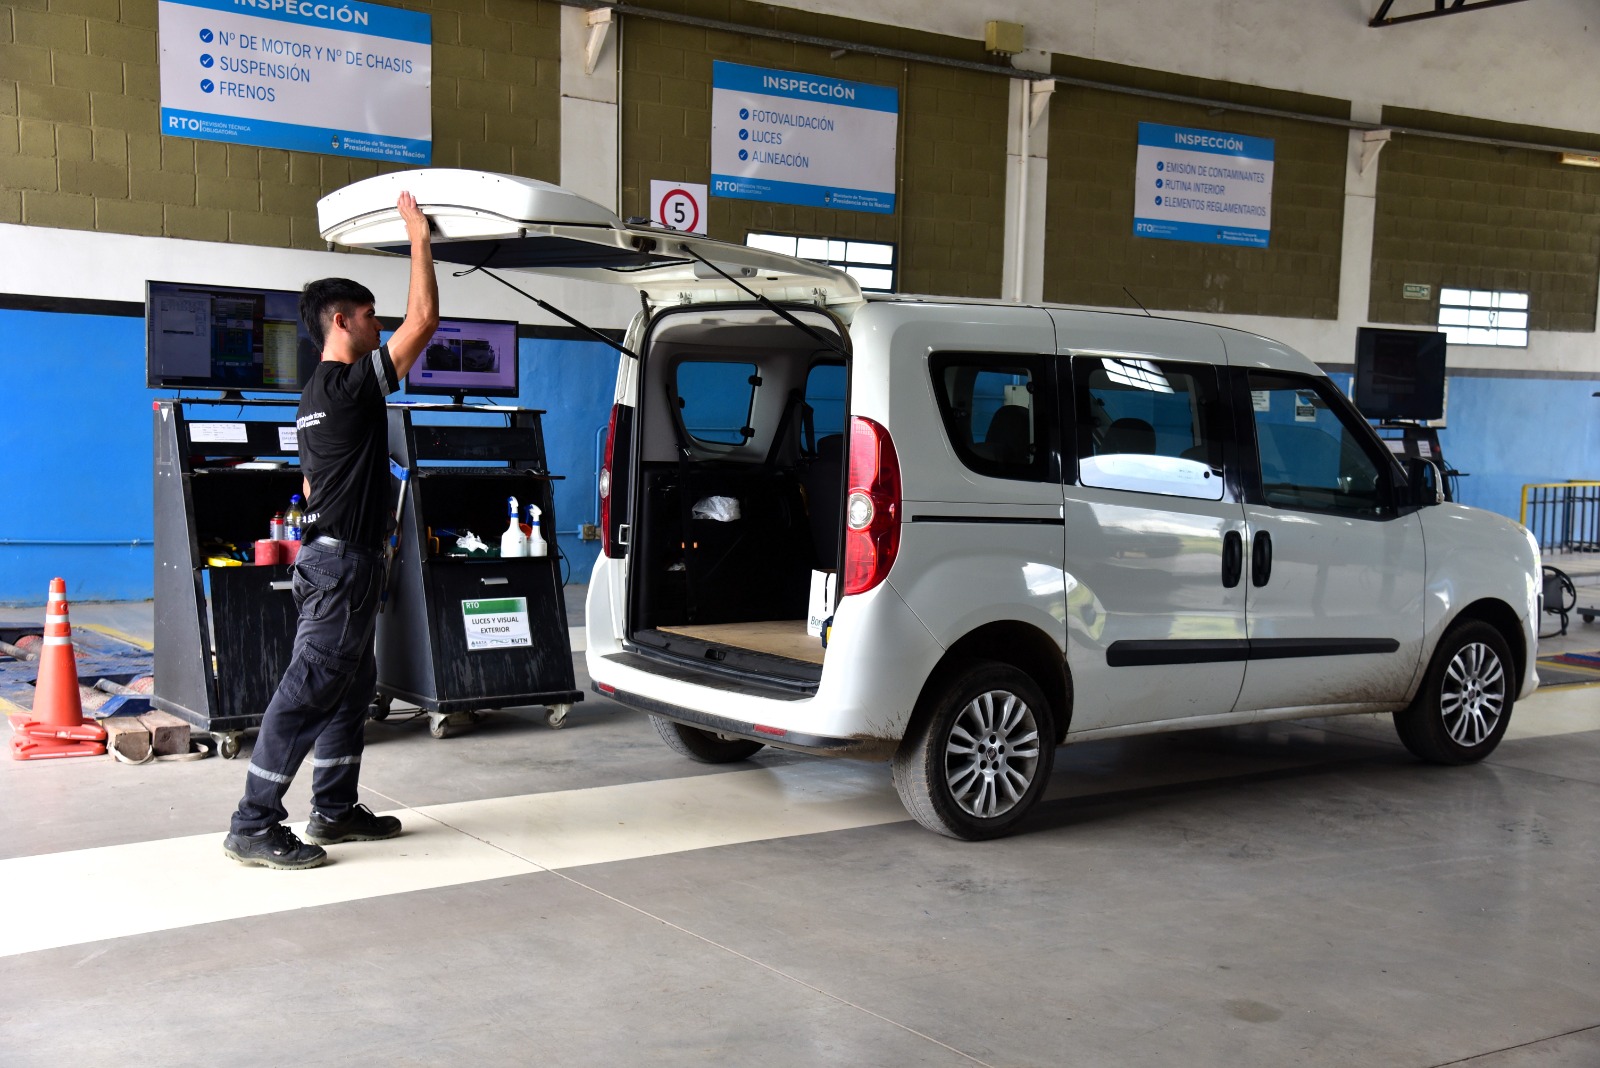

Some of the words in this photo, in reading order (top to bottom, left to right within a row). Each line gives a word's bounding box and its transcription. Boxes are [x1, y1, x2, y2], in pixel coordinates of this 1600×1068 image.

[234, 0, 369, 26] SPECCIÓN
[240, 34, 258, 51] DE
[262, 37, 312, 60] MOTOR
[315, 45, 324, 61] Y
[346, 50, 362, 67] DE
[366, 53, 413, 74] CHASIS
[220, 56, 310, 82] SUSPENSIÓN
[220, 81, 276, 102] FRENOS
[763, 75, 855, 100] INSPECCIÓN
[169, 116, 200, 131] RTO
[202, 120, 228, 129] REVISIÓN
[228, 123, 251, 132] TÉCNICA
[752, 110, 834, 132] FOTOVALIDACIÓN
[202, 127, 238, 136] OBLIGATORIA
[752, 130, 782, 145] LUCES
[344, 138, 370, 146] Ministerio
[379, 141, 407, 150] Transporte
[1174, 132, 1244, 151] INSPECCIÓN
[344, 143, 384, 154] Presidencia
[402, 150, 426, 159] Nación
[752, 150, 809, 168] ALINEACIÓN
[1166, 162, 1196, 175] EMISIÓN
[1198, 166, 1208, 177] DE
[1208, 167, 1265, 184] CONTAMINANTES
[716, 180, 737, 192] RTO
[1165, 180, 1192, 192] RUTINA
[1193, 182, 1226, 195] INTERIOR
[674, 202, 686, 224] 5
[1164, 196, 1205, 211] ELEMENTOS
[1206, 201, 1266, 216] REGLAMENTARIOS
[1136, 222, 1152, 232] RTO
[480, 626, 510, 634] EXTERIOR
